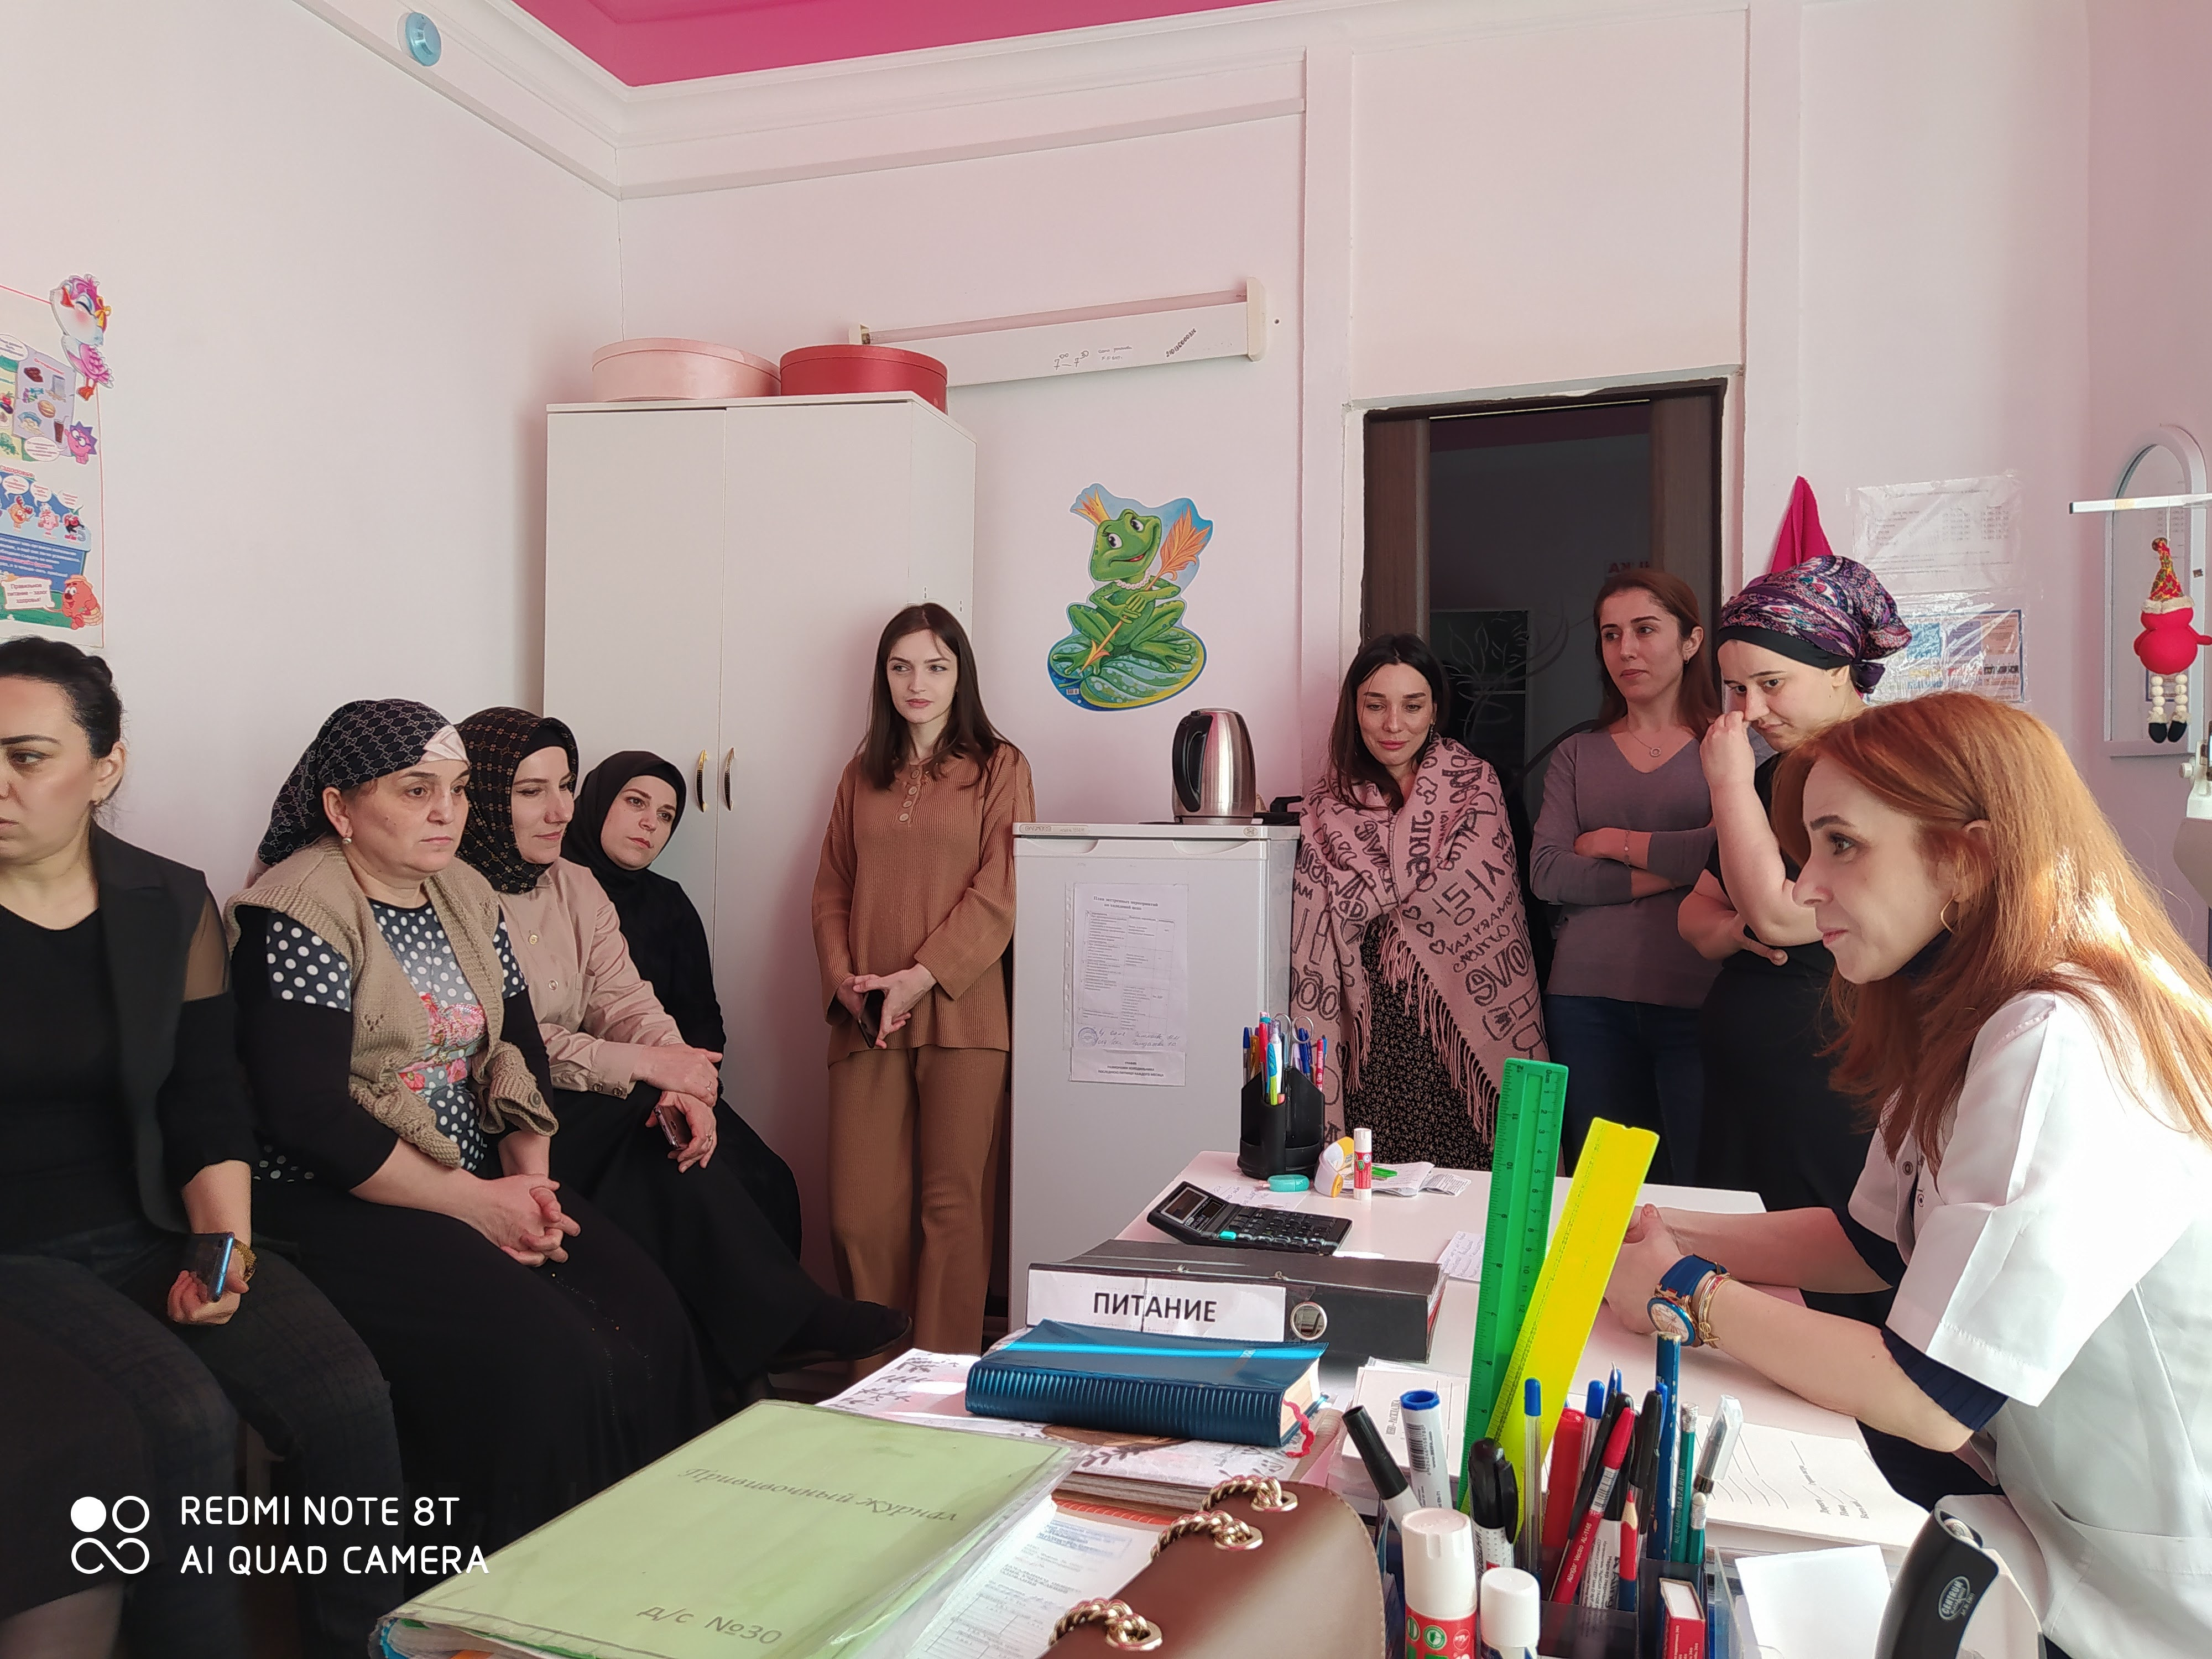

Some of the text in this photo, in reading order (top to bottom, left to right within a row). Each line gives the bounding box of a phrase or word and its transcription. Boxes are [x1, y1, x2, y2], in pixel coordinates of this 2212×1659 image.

[1094, 1292, 1217, 1322] ПИТАНИЕ
[677, 1468, 854, 1504] Прививочный
[1566, 1563, 1577, 1583] Alingar
[1573, 1544, 1584, 1562] Vectro
[1941, 1580, 1964, 1615] CENTRUM
[704, 1616, 782, 1645] №30
